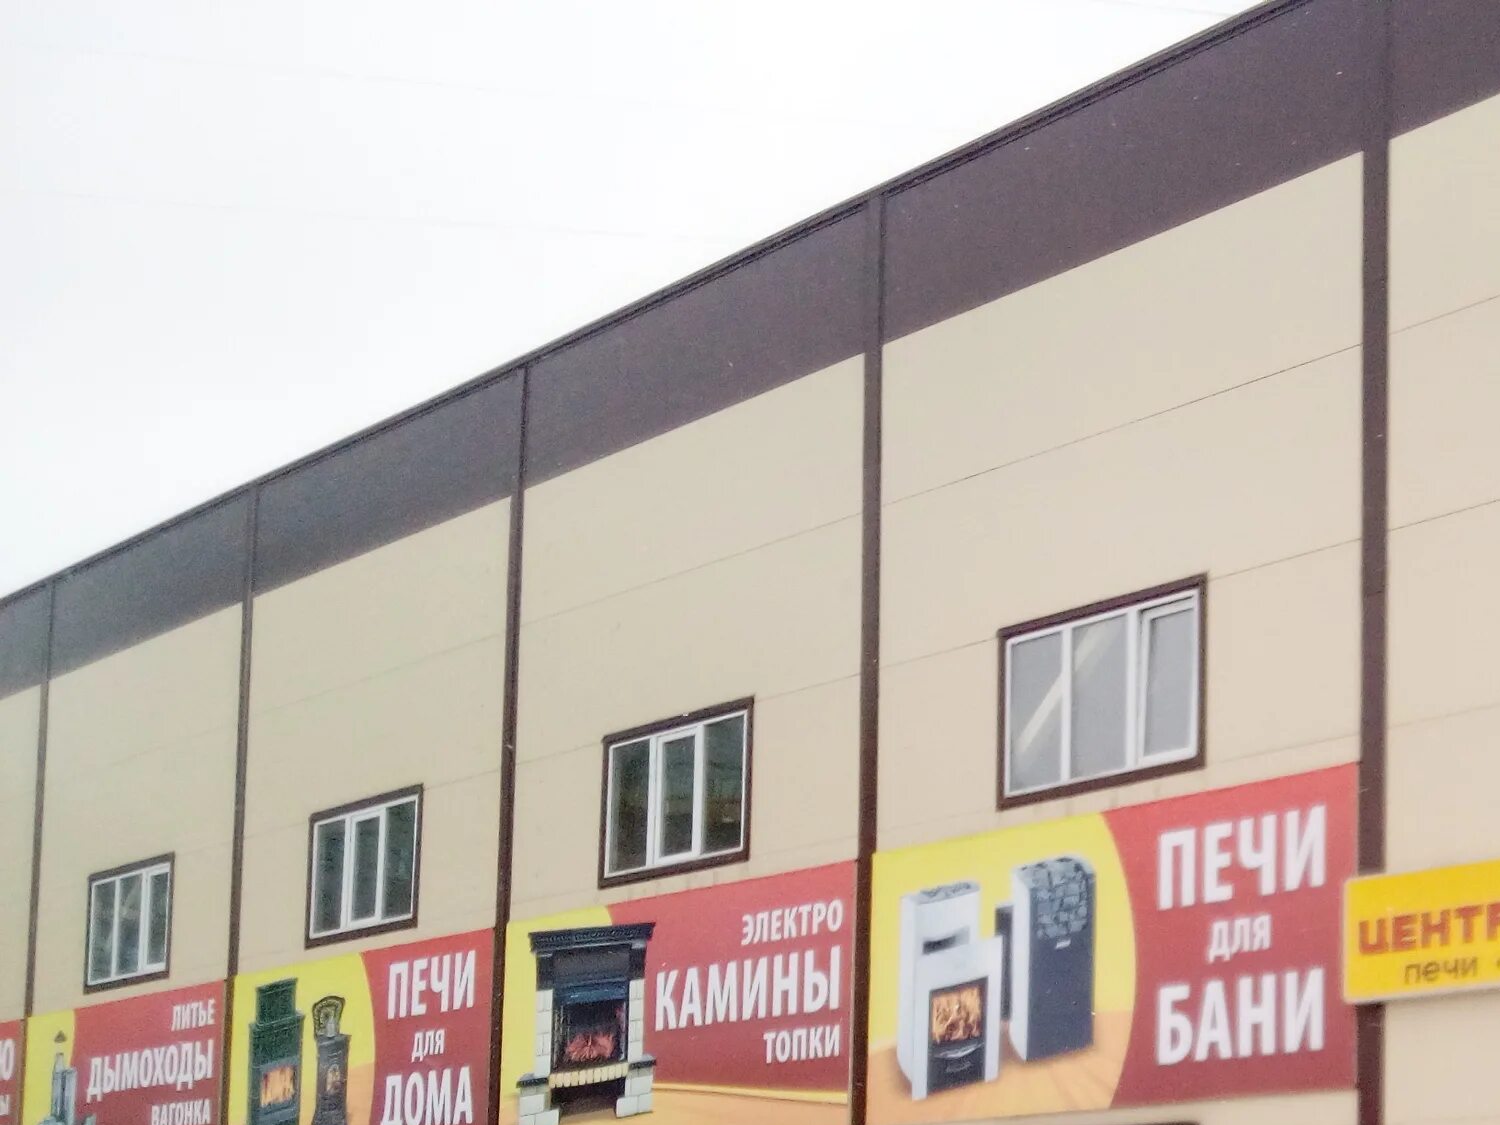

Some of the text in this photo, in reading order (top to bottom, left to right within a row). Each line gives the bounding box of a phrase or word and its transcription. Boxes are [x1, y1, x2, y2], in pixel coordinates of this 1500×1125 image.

[1157, 804, 1327, 912] ПЕЧИ
[740, 899, 844, 947] ЭЛЕКТРО
[170, 997, 216, 1032] ЛИТЬЕ
[386, 950, 477, 1020] ПЕЧИ
[654, 945, 842, 1032] КАМИНЫ
[1156, 967, 1325, 1067] БАНИ
[86, 1039, 215, 1104] ДЫМОХОДЫ
[762, 1024, 841, 1065] ТОПКИ
